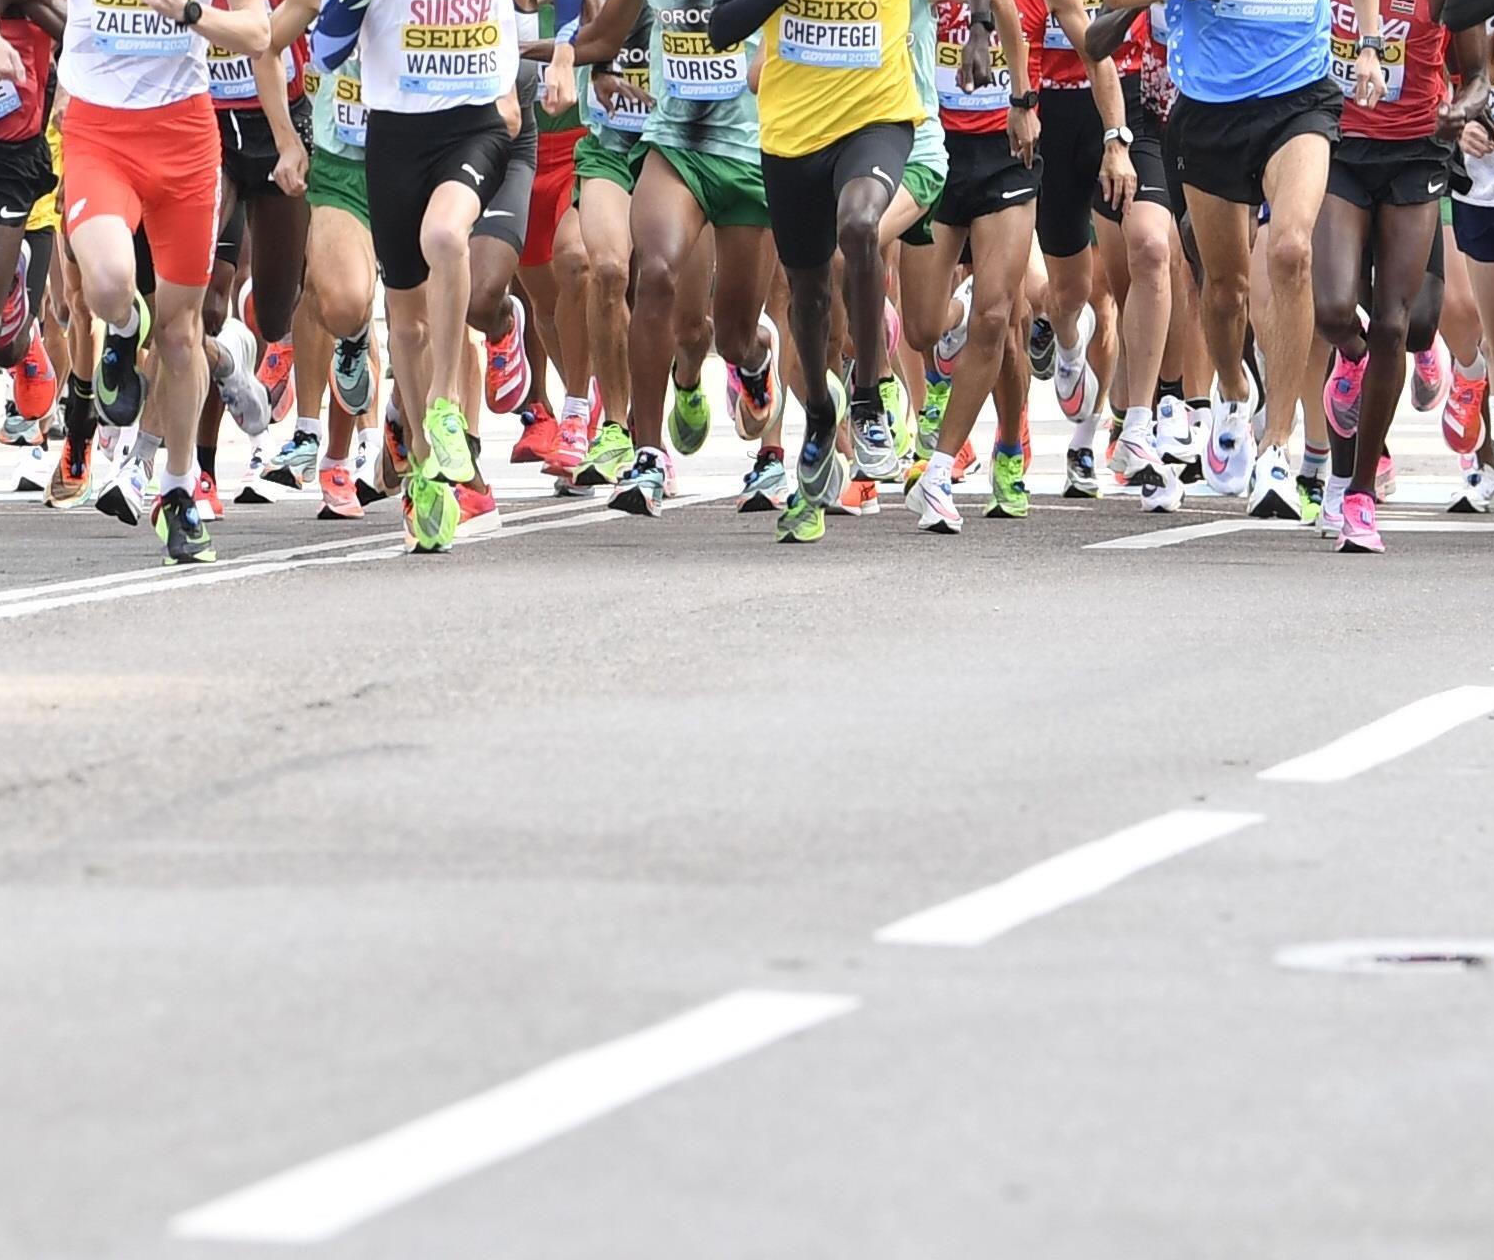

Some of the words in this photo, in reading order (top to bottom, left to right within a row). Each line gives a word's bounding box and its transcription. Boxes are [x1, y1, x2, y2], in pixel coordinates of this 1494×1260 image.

[405, 25, 498, 49] SEIKO
[784, 19, 876, 47] CHEPTEGEI
[406, 51, 497, 76] WANDERS
[667, 58, 738, 81] TORISS
